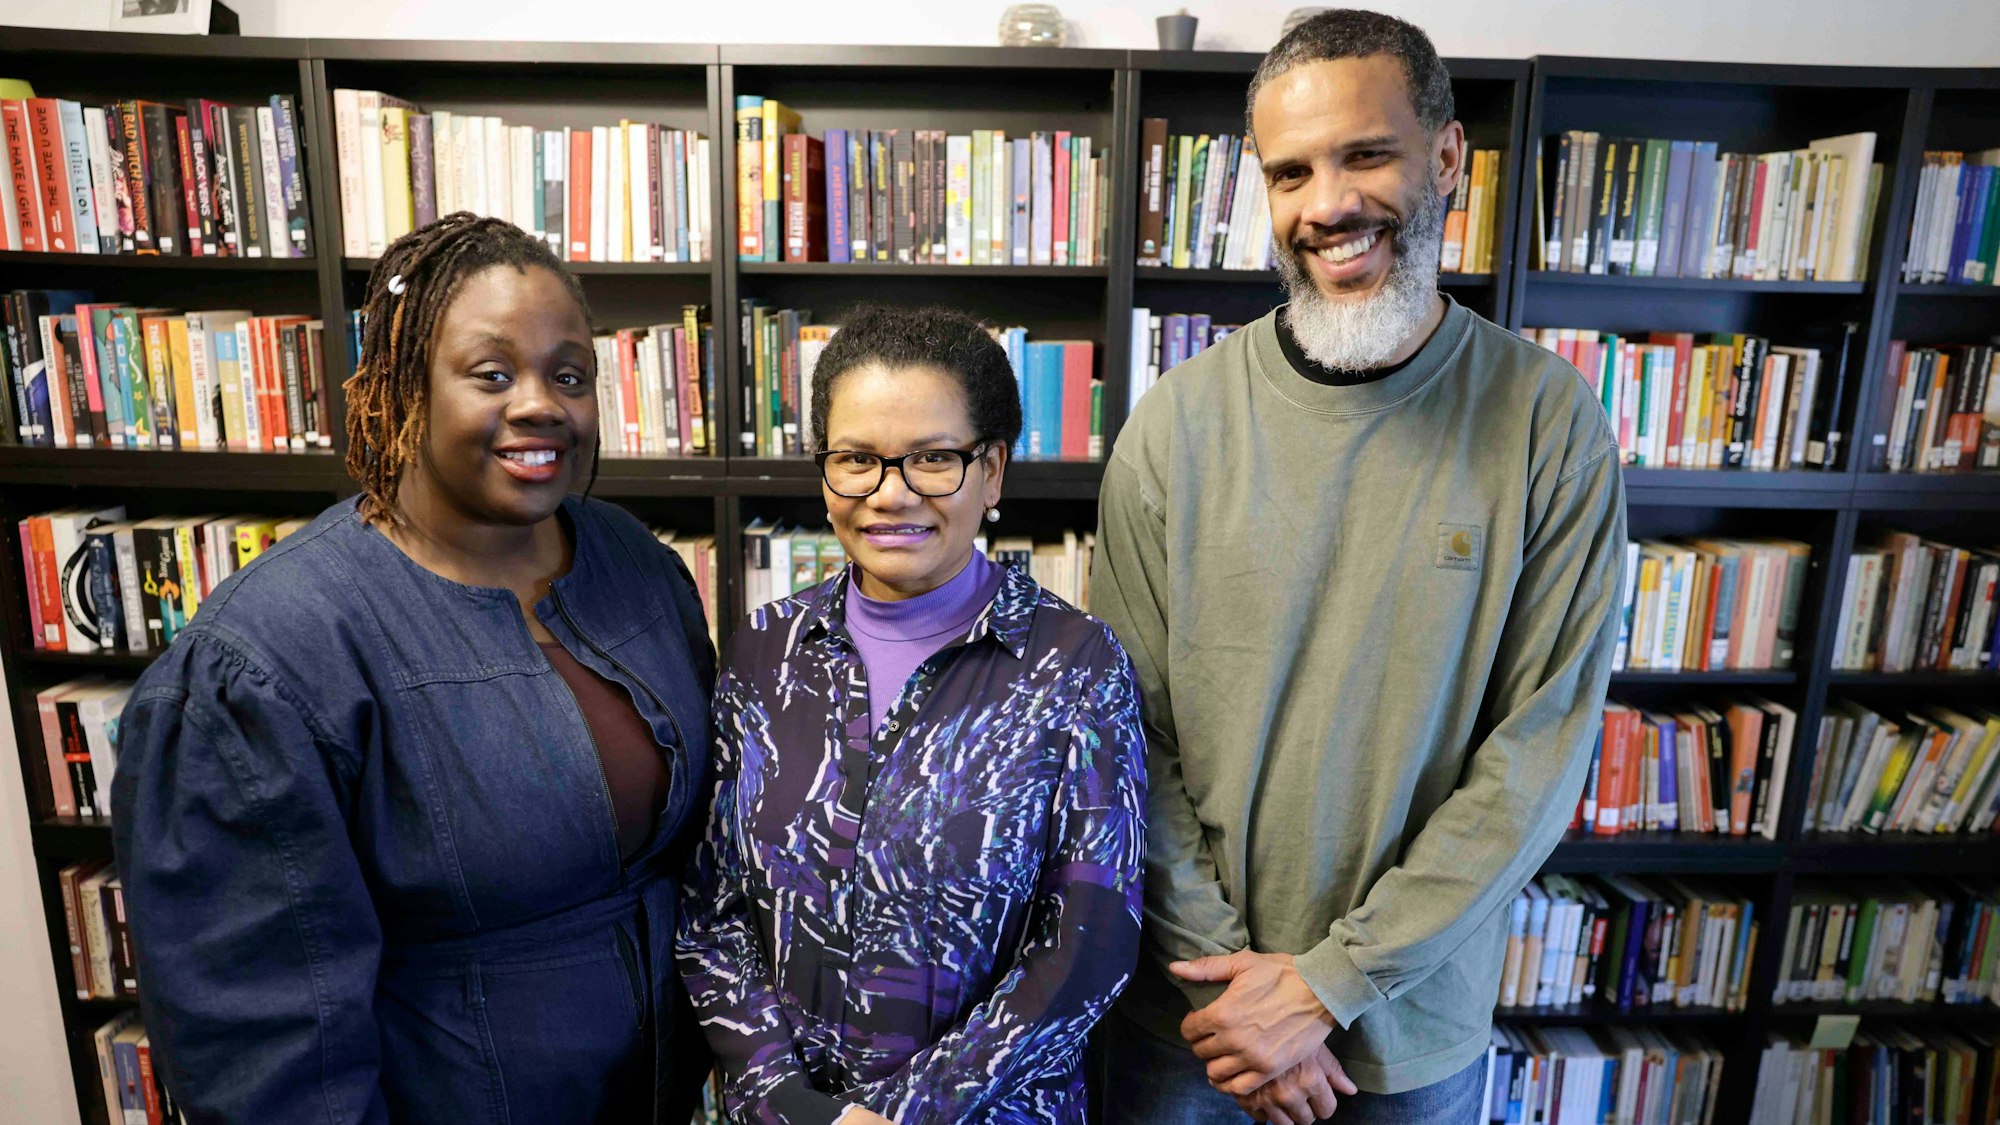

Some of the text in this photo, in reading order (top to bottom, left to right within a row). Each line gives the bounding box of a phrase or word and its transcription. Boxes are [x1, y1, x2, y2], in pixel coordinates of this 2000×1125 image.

[123, 113, 137, 139] BAD
[281, 99, 291, 123] BLACK
[7, 117, 19, 141] THE
[11, 146, 26, 180] HATE
[36, 107, 58, 207] THE HATE U GIVE
[127, 141, 142, 179] WITCH
[193, 141, 206, 180] BLACK
[17, 184, 27, 193] U
[69, 141, 82, 174] LITTLE
[76, 187, 90, 217] LION
[238, 124, 258, 240] WITCHES STEEPED IN GOLD
[291, 172, 302, 201] MARLON
[19, 197, 32, 228] GIVE
[131, 180, 148, 231] BURNING
[197, 181, 210, 216] VEINS
[285, 186, 296, 210] JAMES
[831, 165, 845, 246] AMERICANAH
[113, 324, 127, 377] LOT
[148, 323, 160, 346] THE
[151, 348, 163, 373] OLD
